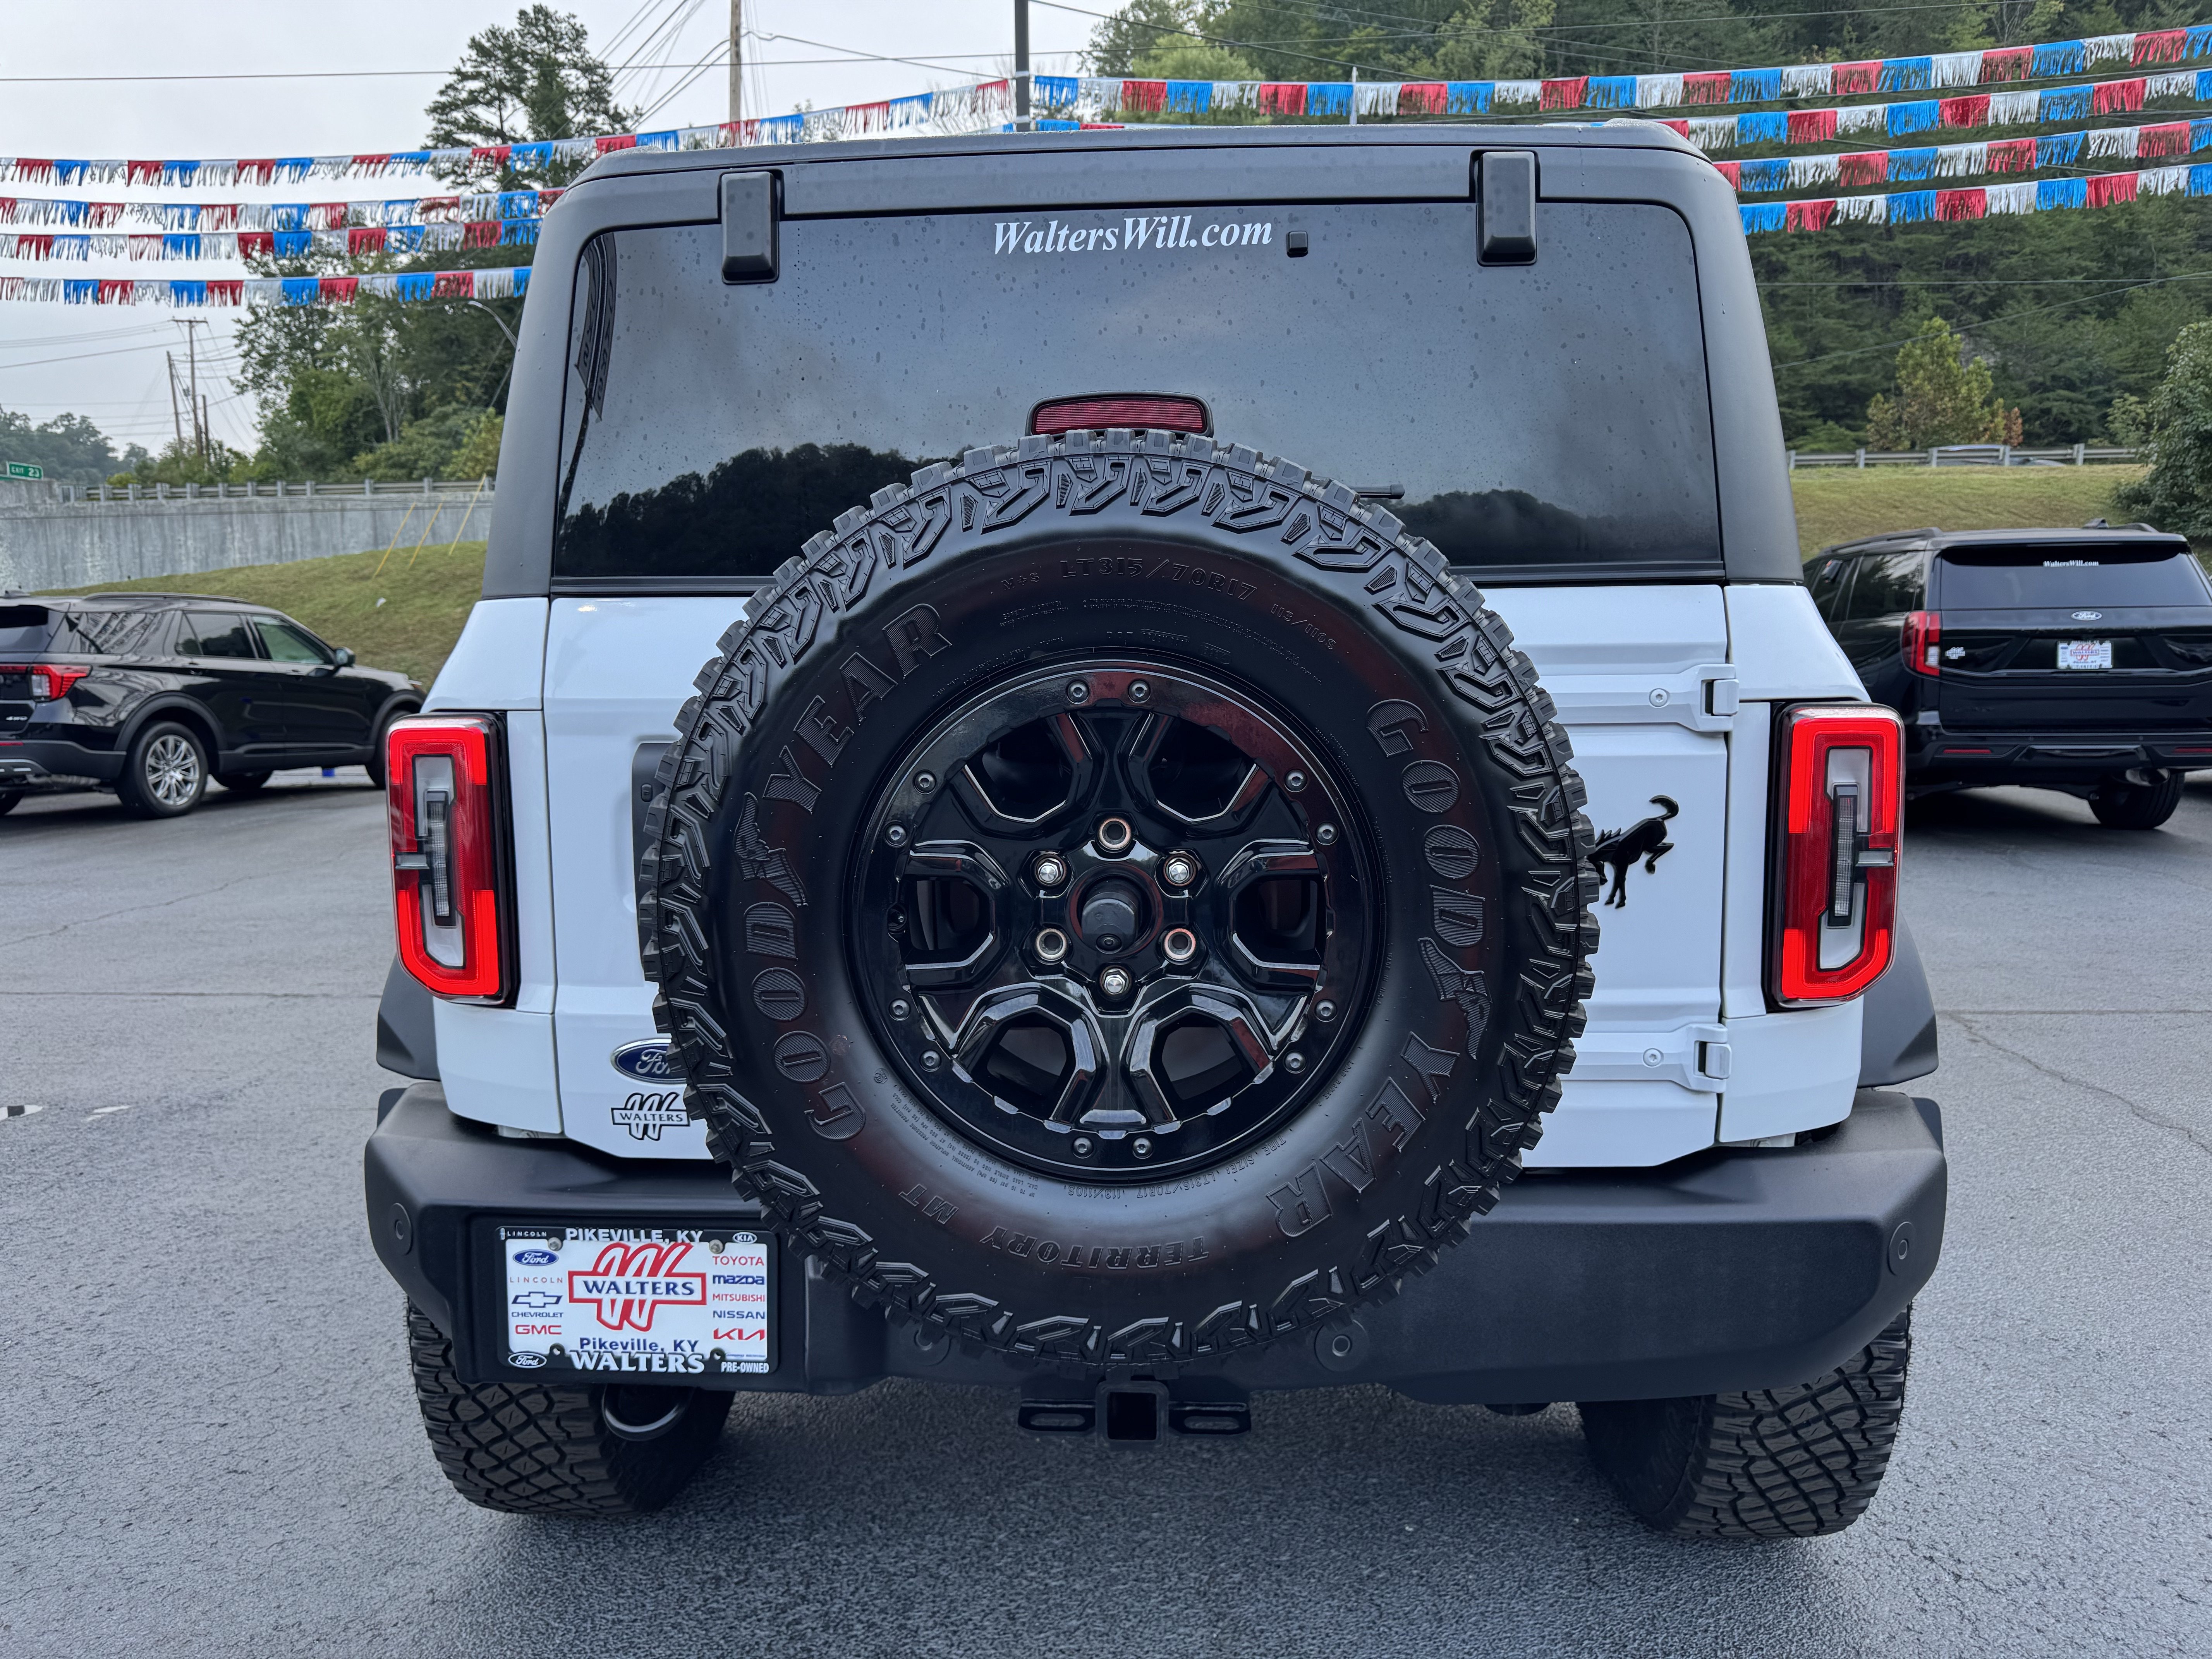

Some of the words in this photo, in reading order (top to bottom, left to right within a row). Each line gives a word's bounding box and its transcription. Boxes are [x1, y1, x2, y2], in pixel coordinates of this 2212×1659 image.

[994, 215, 1273, 254] WaltersWill.com
[29, 467, 40, 477] 23
[1060, 557, 1257, 601] LT315/70R17
[1270, 603, 1337, 650] 113/110S
[620, 1113, 683, 1122] WALTERS
[1262, 1135, 1286, 1156] TIRE
[1225, 1154, 1255, 1175] SIZE:
[1068, 1186, 1121, 1199] 113/110S
[1137, 1175, 1217, 1199] LT315/70R17
[898, 1183, 960, 1224] MT
[565, 1228, 669, 1244] PIKEVILLE,
[677, 1230, 703, 1243] KY
[979, 1226, 1210, 1270] TERRITORY
[522, 1252, 550, 1264] Ford
[713, 1256, 764, 1266] TOYOTA
[583, 1280, 694, 1295] WALTERS
[713, 1293, 765, 1302] MITSUBISHI
[713, 1310, 765, 1319] NISSAN
[515, 1324, 562, 1335] GMC
[580, 1338, 665, 1353] Pikeville,
[673, 1339, 699, 1352] KY
[515, 1355, 539, 1366] Ford
[570, 1350, 705, 1374] WALTERS
[721, 1362, 769, 1374] PRE-OWNED
